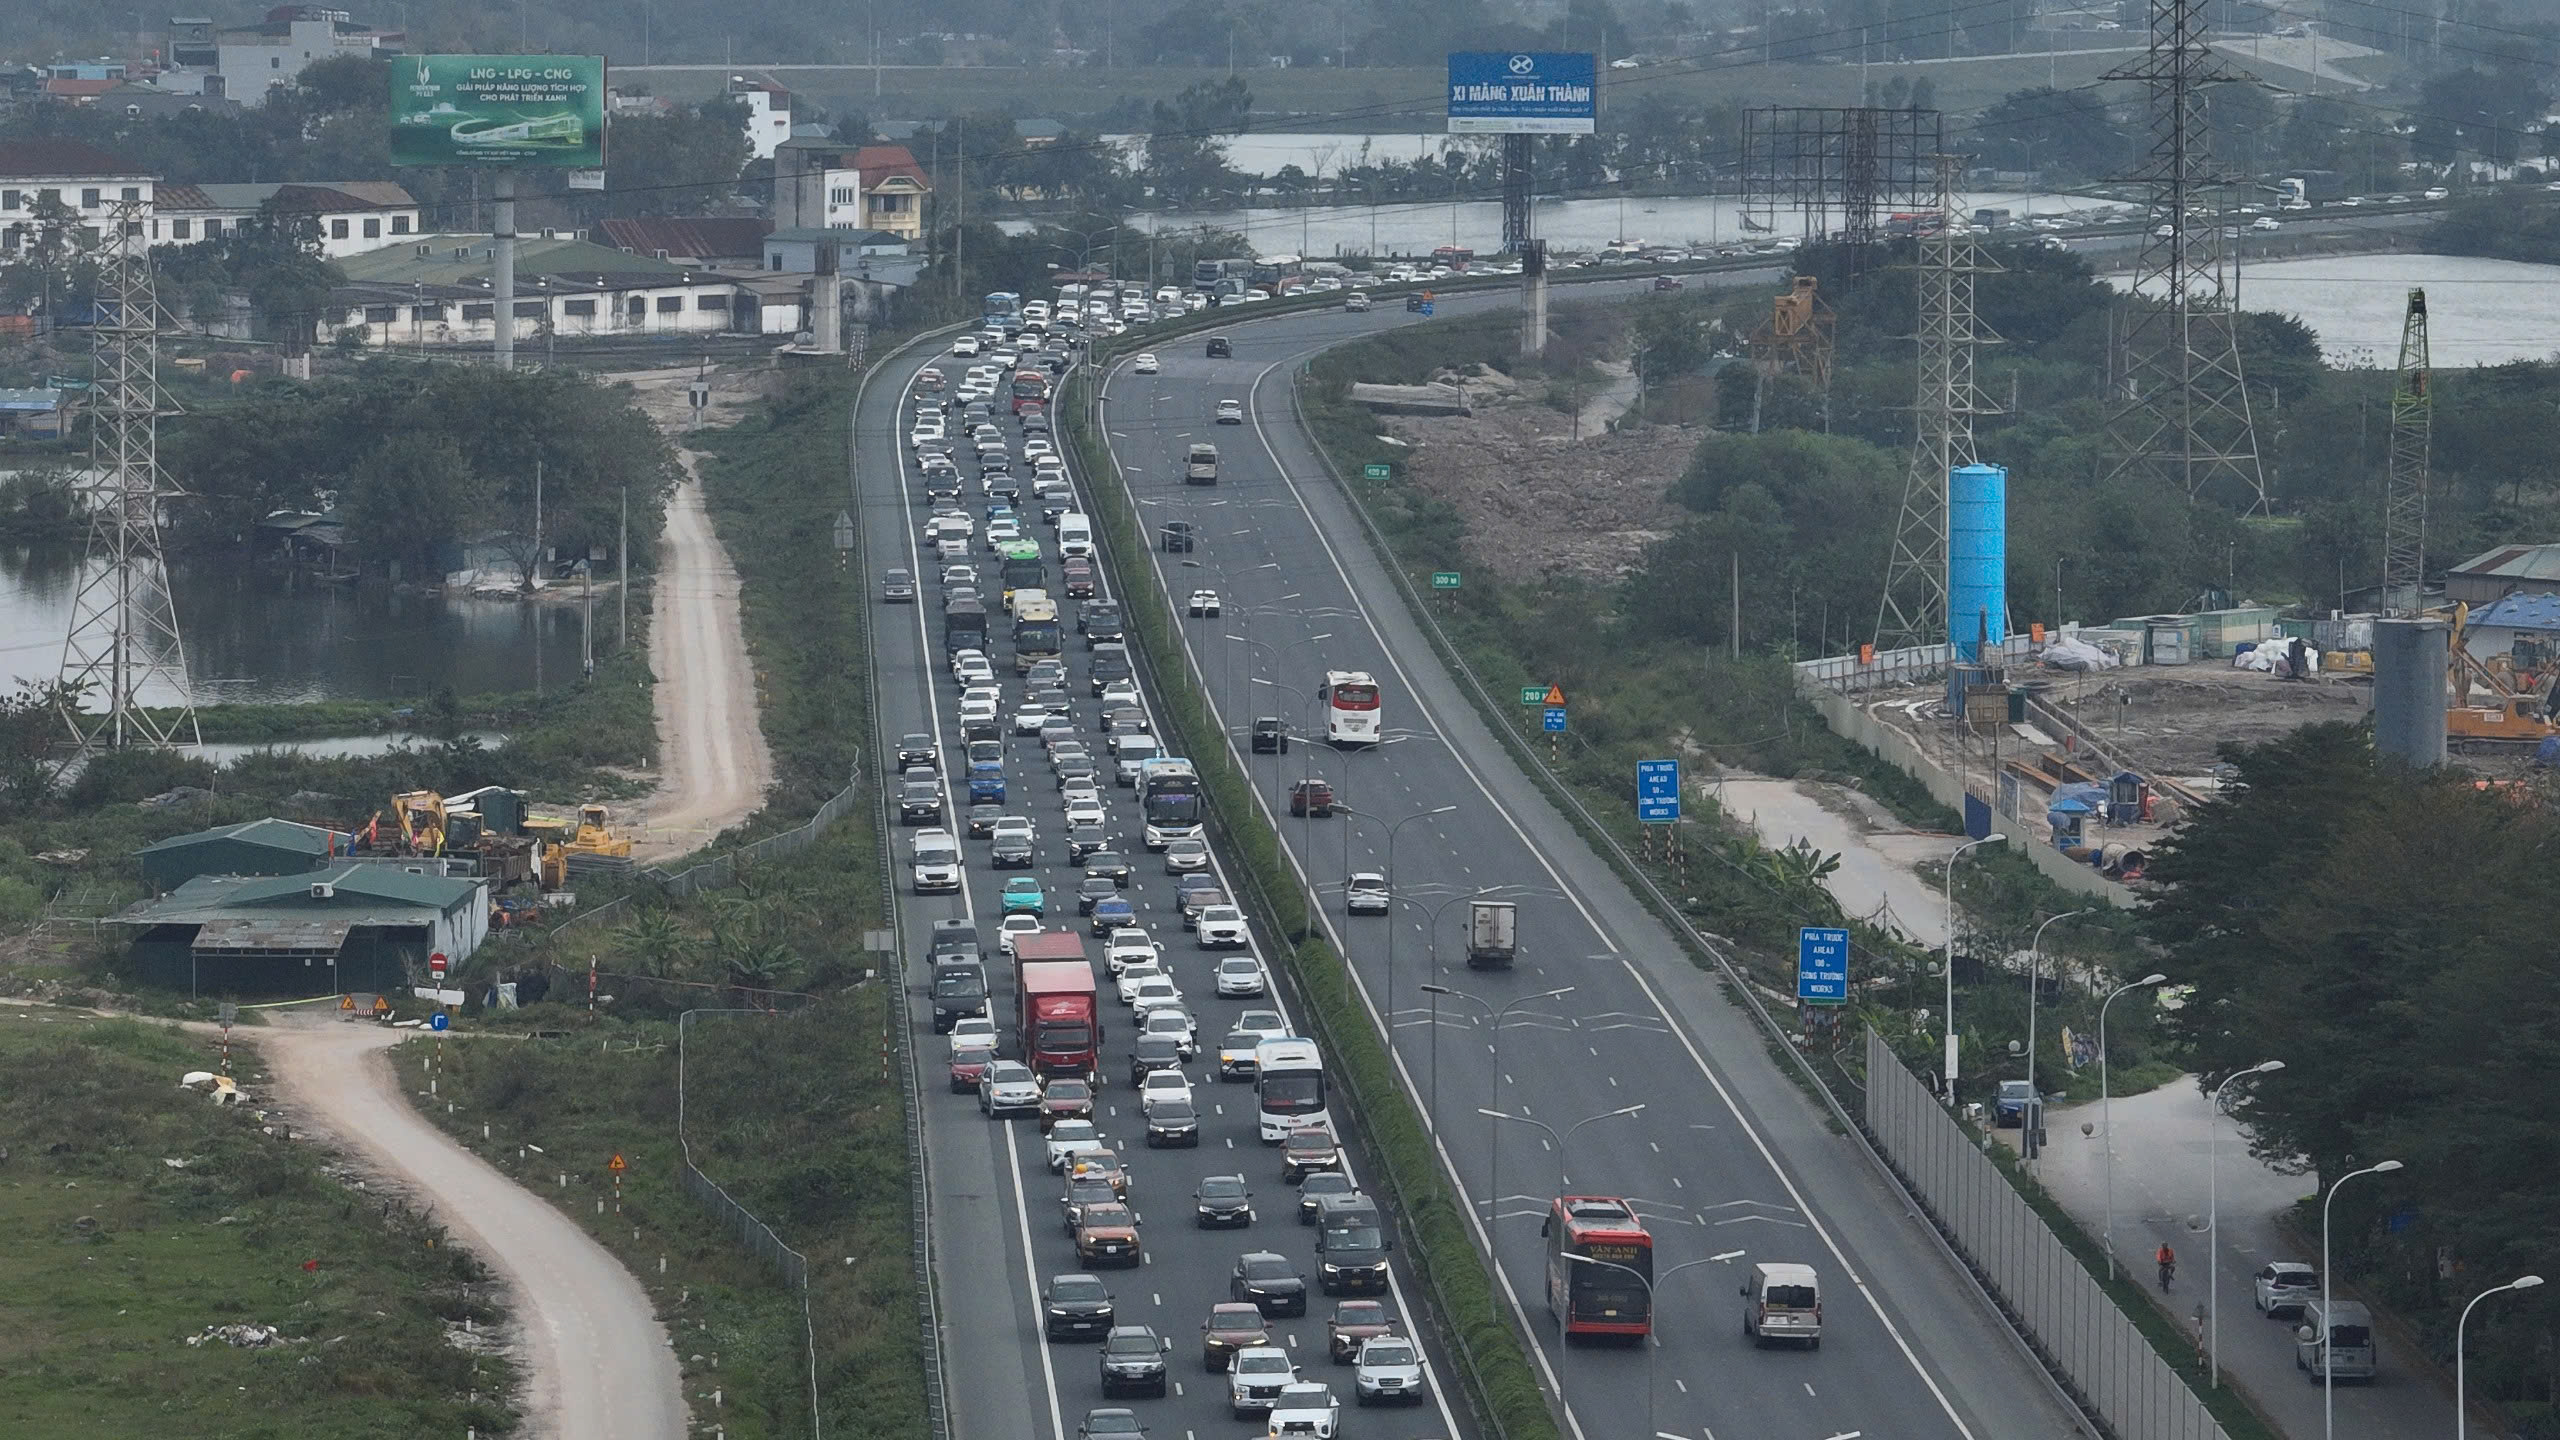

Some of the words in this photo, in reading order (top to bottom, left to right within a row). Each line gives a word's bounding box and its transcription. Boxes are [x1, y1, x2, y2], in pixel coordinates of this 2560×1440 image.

[470, 68, 496, 79] LNG
[507, 68, 532, 79] LPG
[543, 68, 572, 80] CNG
[456, 82, 473, 91] GIẢI
[474, 81, 495, 91] PHÁP
[496, 82, 519, 91] NĂNG
[520, 82, 549, 93] LƯỢNG
[550, 82, 568, 92] TÍCH
[569, 83, 587, 93] HỢP
[1452, 85, 1466, 101] XI
[1469, 81, 1507, 101] MĂNG
[1510, 82, 1545, 102] XUÂN
[1547, 82, 1590, 102] THÀNH
[479, 93, 497, 101] CHO
[499, 92, 519, 101] PHÁT
[521, 92, 543, 102] TRIỂN
[544, 94, 567, 102] XANH
[1524, 691, 1540, 701] 200
[1813, 946, 1834, 954] AHEAD
[1801, 970, 1817, 980] CÔNG
[1811, 985, 1833, 993] WORKS
